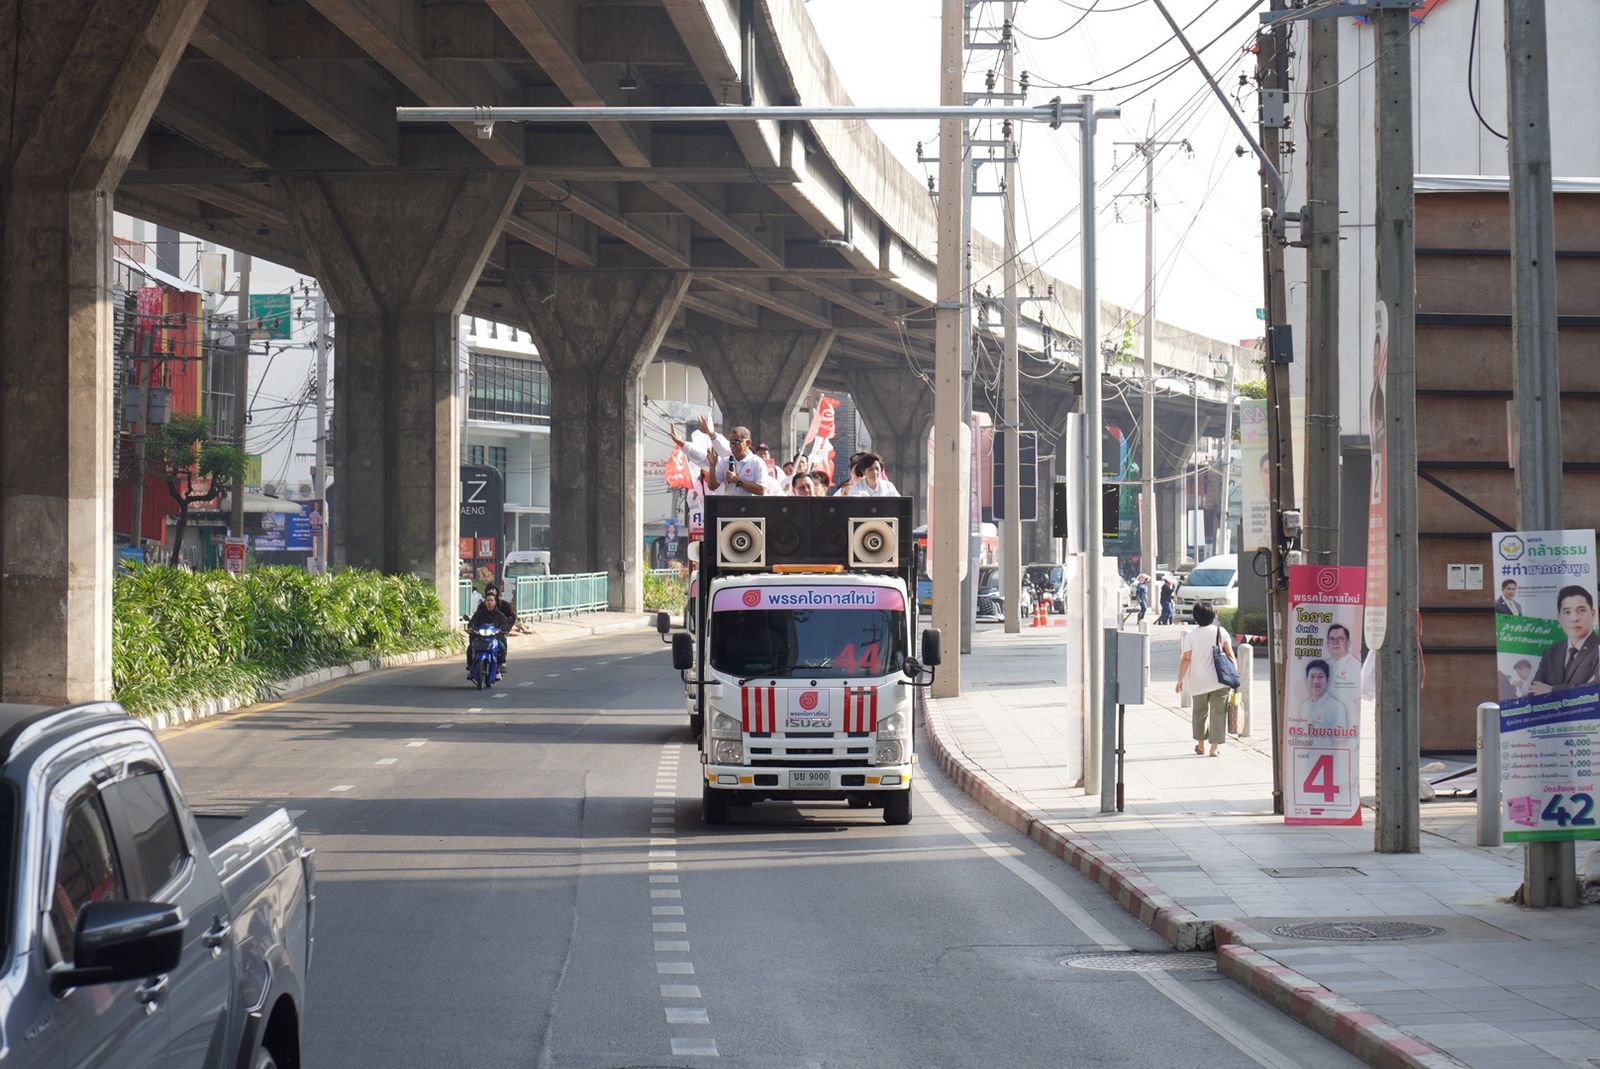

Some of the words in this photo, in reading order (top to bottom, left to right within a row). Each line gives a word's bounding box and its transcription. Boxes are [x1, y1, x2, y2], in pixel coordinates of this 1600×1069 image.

[1528, 544, 1588, 557] กล้าธรรม
[768, 590, 876, 605] พรรคโอกาสใหม่
[1293, 591, 1361, 604] พรรคโอกาสใหม่
[1295, 607, 1333, 623] โอกาส
[833, 642, 881, 674] 44
[785, 719, 832, 728] ISUZU
[1564, 738, 1591, 747] 40,000
[1569, 749, 1592, 757] 1,000
[1569, 760, 1592, 769] 1,000
[809, 772, 829, 781] 9000
[1302, 754, 1340, 803] 4
[1541, 792, 1597, 827] 42
